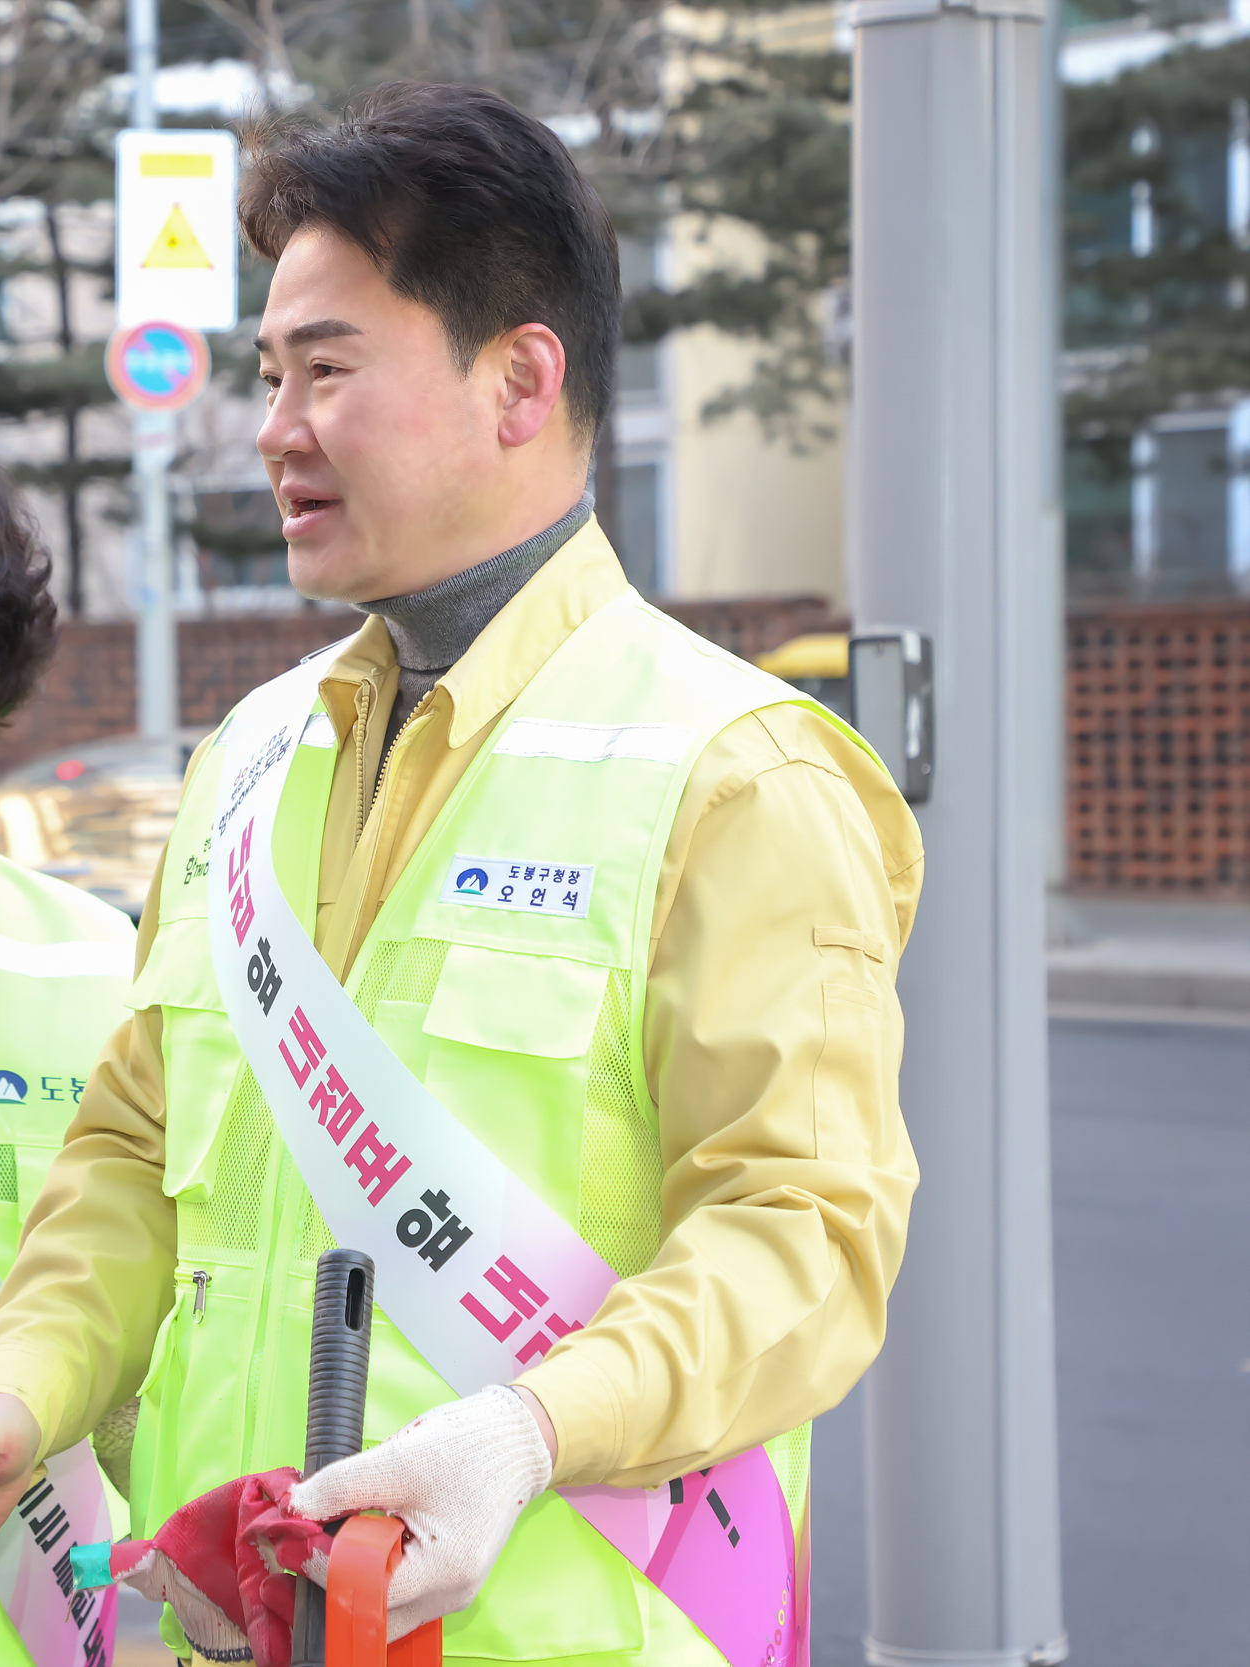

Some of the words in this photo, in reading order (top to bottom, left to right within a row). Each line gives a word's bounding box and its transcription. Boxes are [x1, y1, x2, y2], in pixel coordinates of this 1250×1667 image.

[508, 865, 581, 885] 도봉구청장
[247, 936, 283, 1017] 앞
[278, 1005, 413, 1208] 내점포
[396, 1188, 474, 1273] 앞
